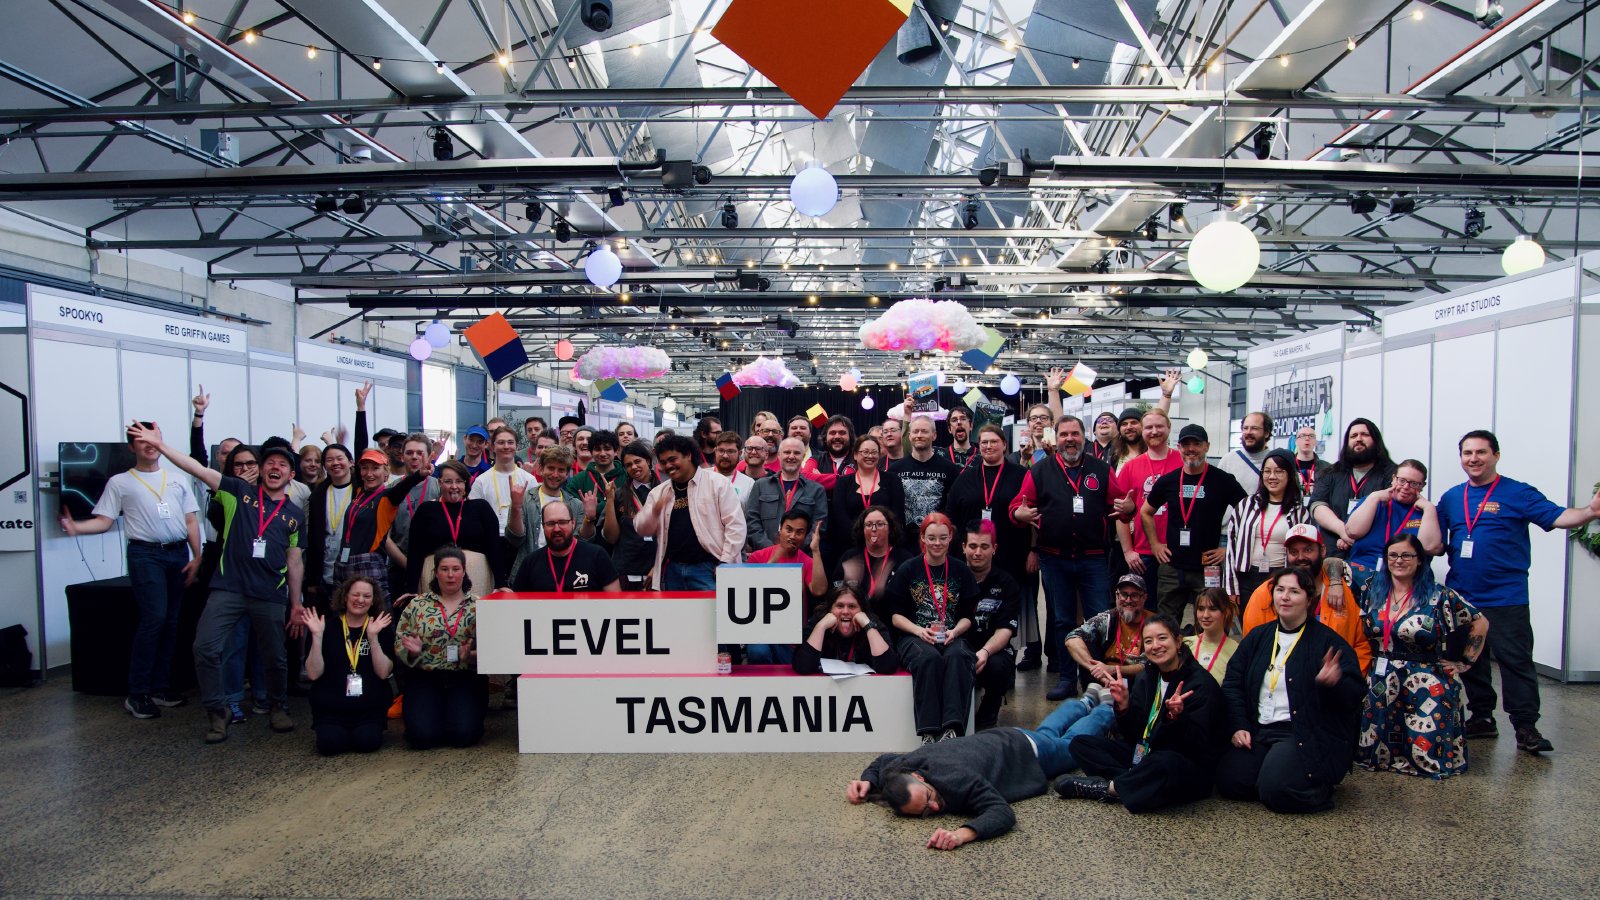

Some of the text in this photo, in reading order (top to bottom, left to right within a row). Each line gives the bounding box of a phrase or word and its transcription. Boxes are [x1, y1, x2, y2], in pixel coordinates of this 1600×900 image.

[59, 306, 103, 324] SPOOKYQ
[1434, 295, 1501, 320] CRYPT RAT STUDIOS
[165, 324, 231, 344] RED GRIFFIN GAMES
[336, 355, 375, 369] LINDSAY MANSFIELD
[1279, 347, 1289, 357] GAME
[1262, 376, 1332, 418] MINECRAFT
[728, 588, 790, 624] UP
[524, 619, 669, 655] LEVEL
[616, 696, 873, 734] TASMANIA
